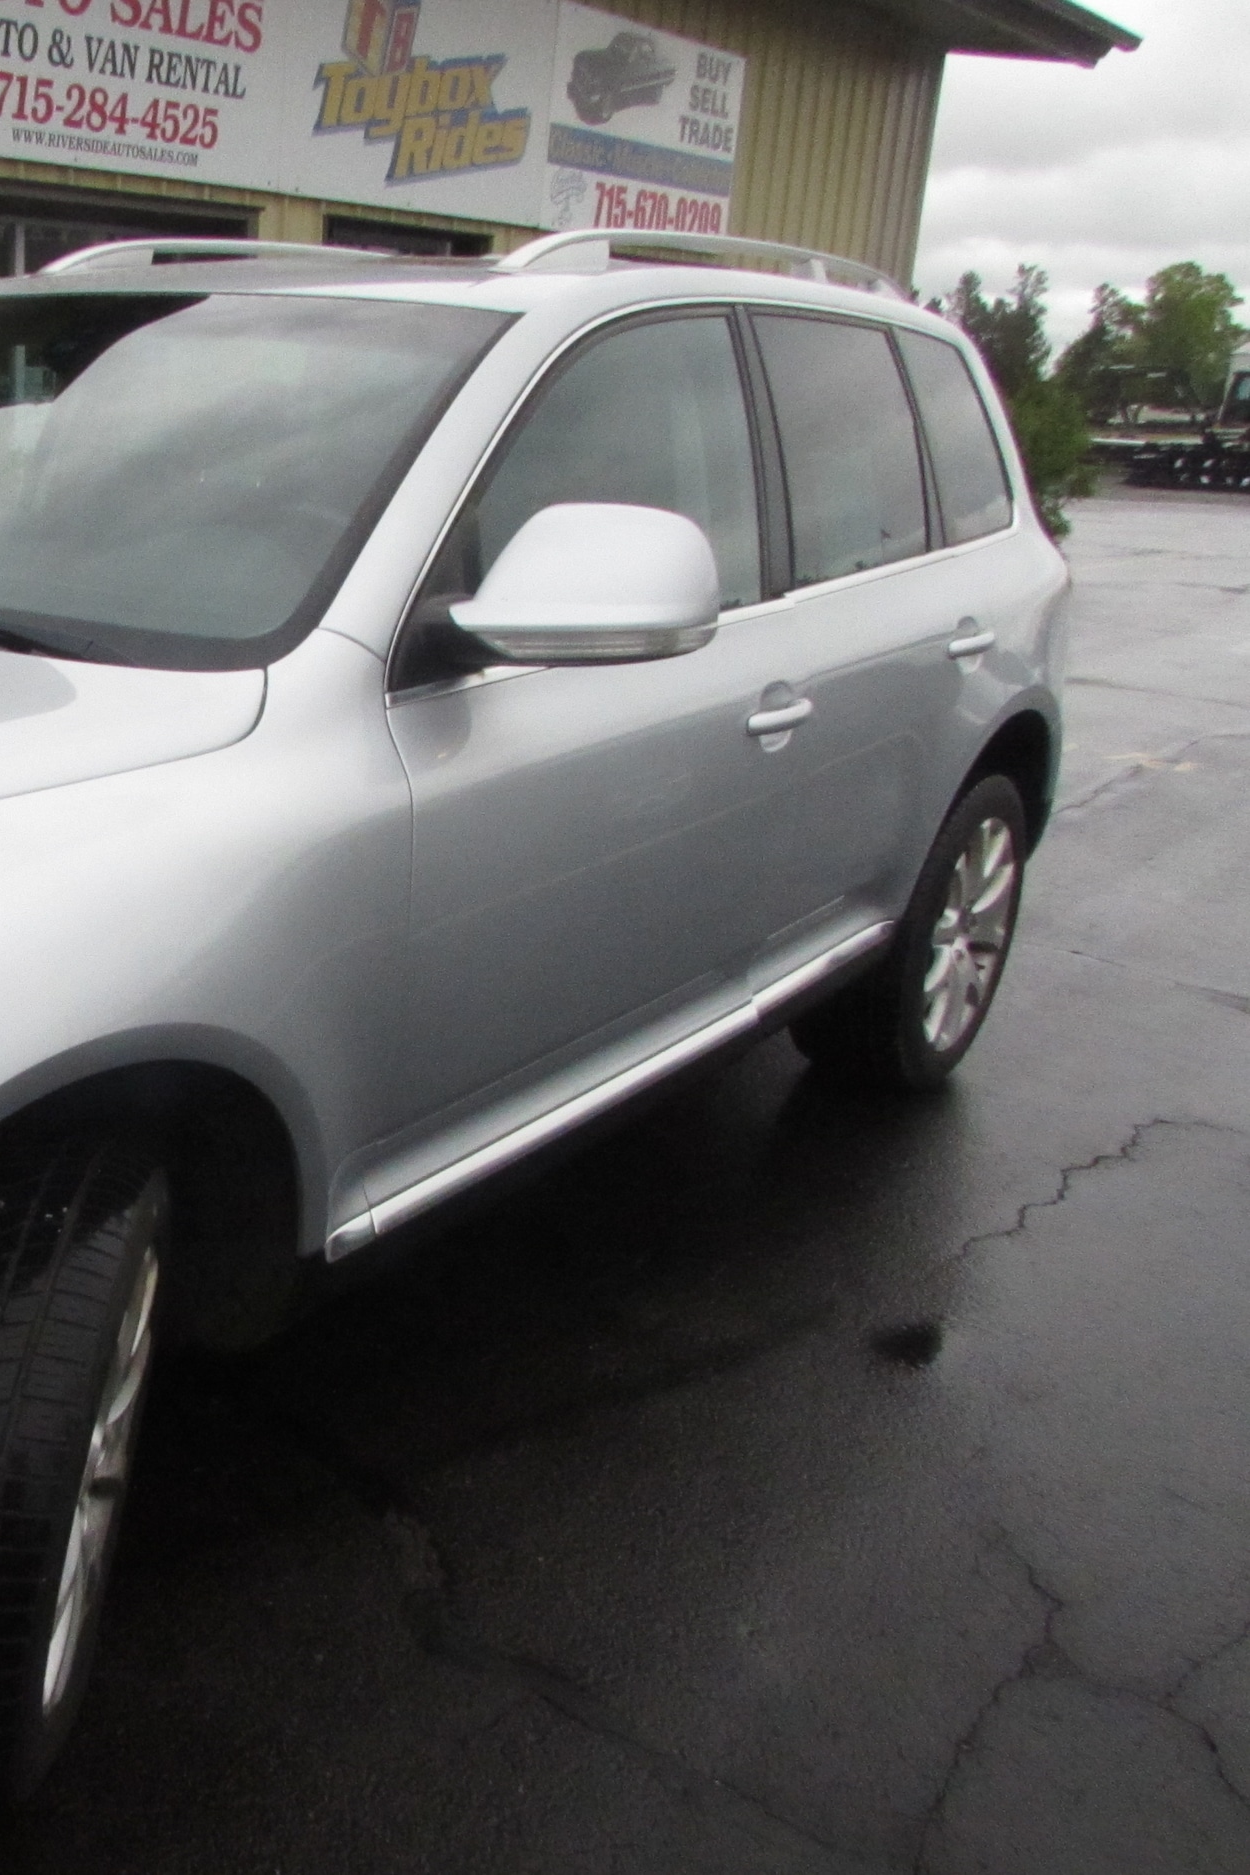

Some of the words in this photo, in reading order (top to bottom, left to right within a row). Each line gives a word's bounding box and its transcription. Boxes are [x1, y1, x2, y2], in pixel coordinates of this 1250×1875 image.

[110, 0, 263, 54] SALES
[48, 28, 74, 69] &
[84, 34, 140, 80] VAN
[145, 48, 247, 99] RENTAL
[695, 52, 731, 86] BUY
[314, 54, 507, 141] Toybox
[688, 84, 728, 119] SELL
[11, 127, 199, 167] WWW.RIVERSIDEAUTOSALES.COM
[387, 108, 531, 185] Rides
[678, 114, 734, 152] TRADE
